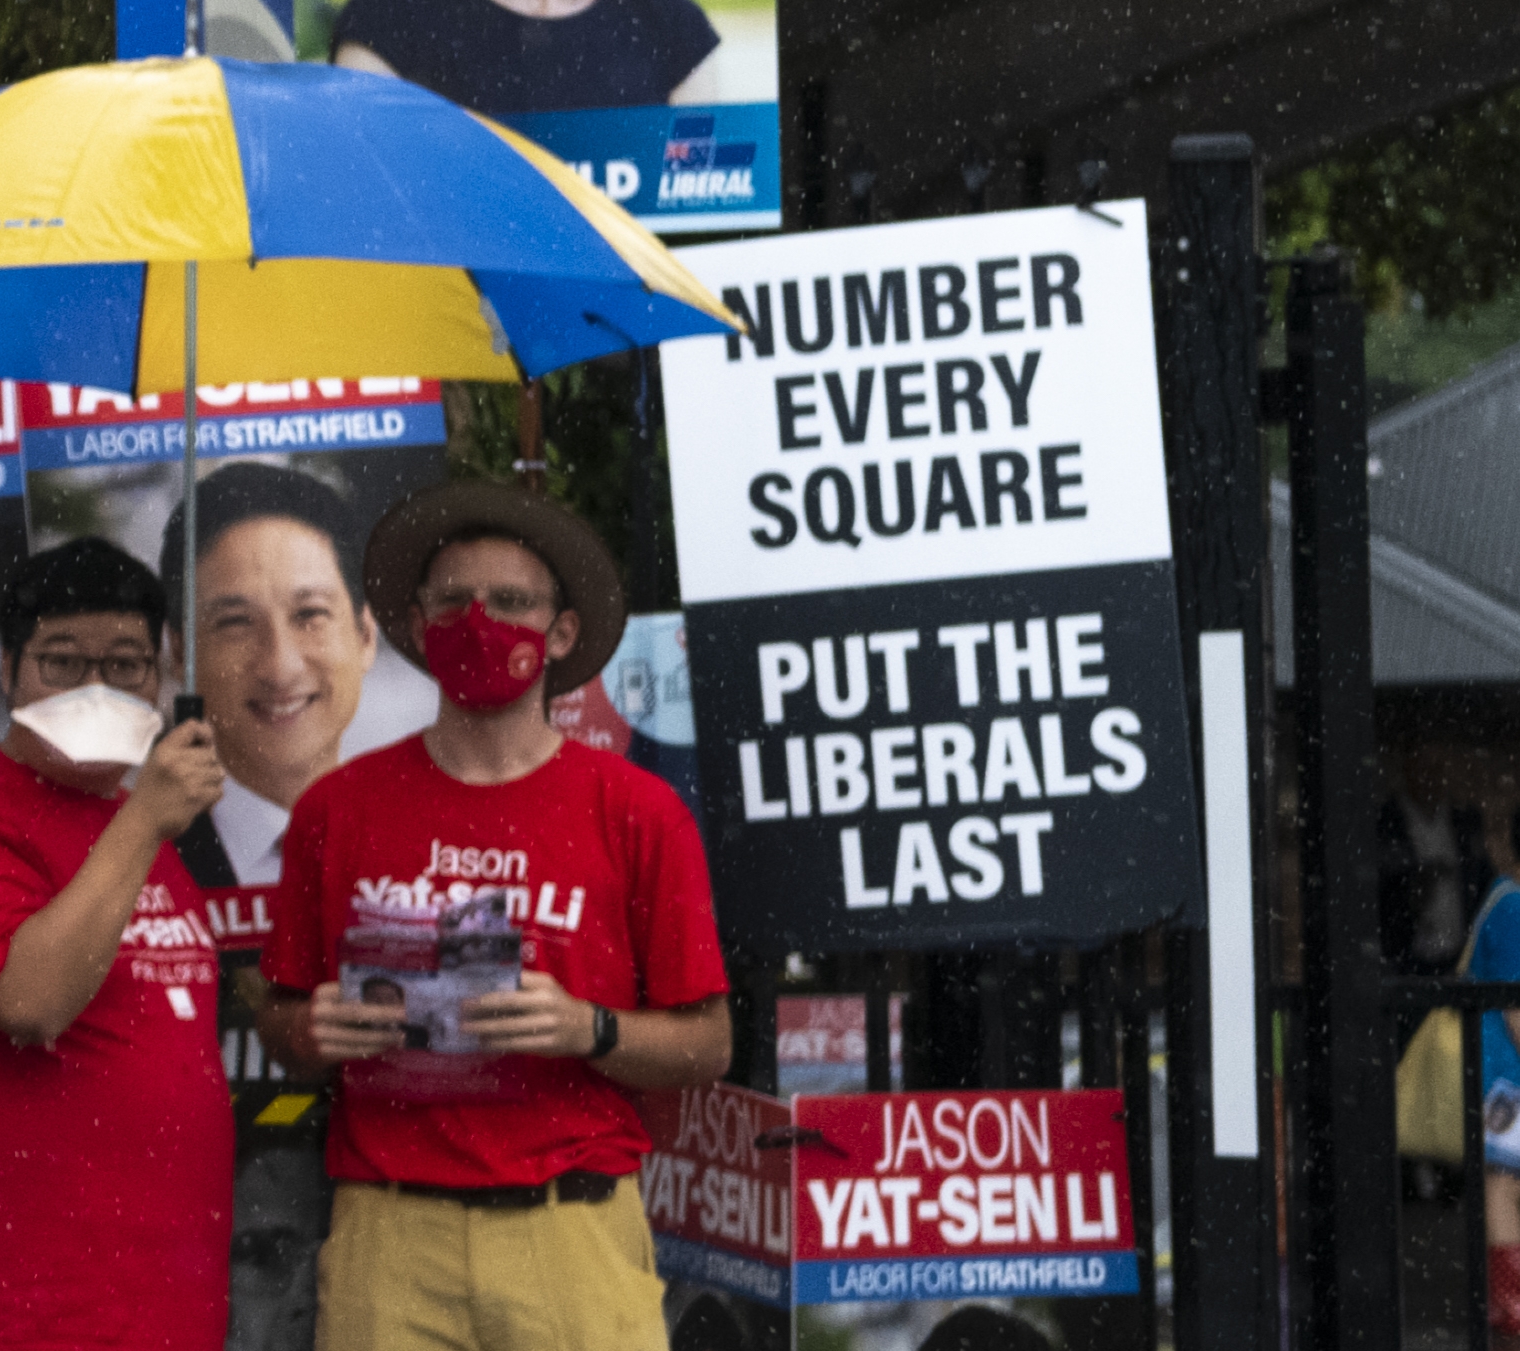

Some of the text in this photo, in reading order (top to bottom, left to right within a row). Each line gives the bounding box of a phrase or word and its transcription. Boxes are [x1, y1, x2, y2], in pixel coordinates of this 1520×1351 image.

[659, 170, 754, 198] LIBERAL
[722, 251, 1084, 361] NUMBER
[65, 428, 157, 462] LABOR
[224, 409, 405, 448] STRATHFIELD
[774, 349, 1042, 451] EVERY
[748, 444, 1088, 551] SQUARE
[758, 613, 1109, 724] PUT THE
[739, 708, 1147, 822] LIBERALS
[422, 837, 528, 880] Jason
[841, 813, 1053, 910] LAST
[534, 881, 587, 933] Li
[673, 1086, 761, 1170] JASON
[874, 1097, 1052, 1173] JASON
[807, 1171, 1119, 1249] YAT-SEN LI
[830, 1256, 1107, 1297] LABOR FOR STRATHFIELD
